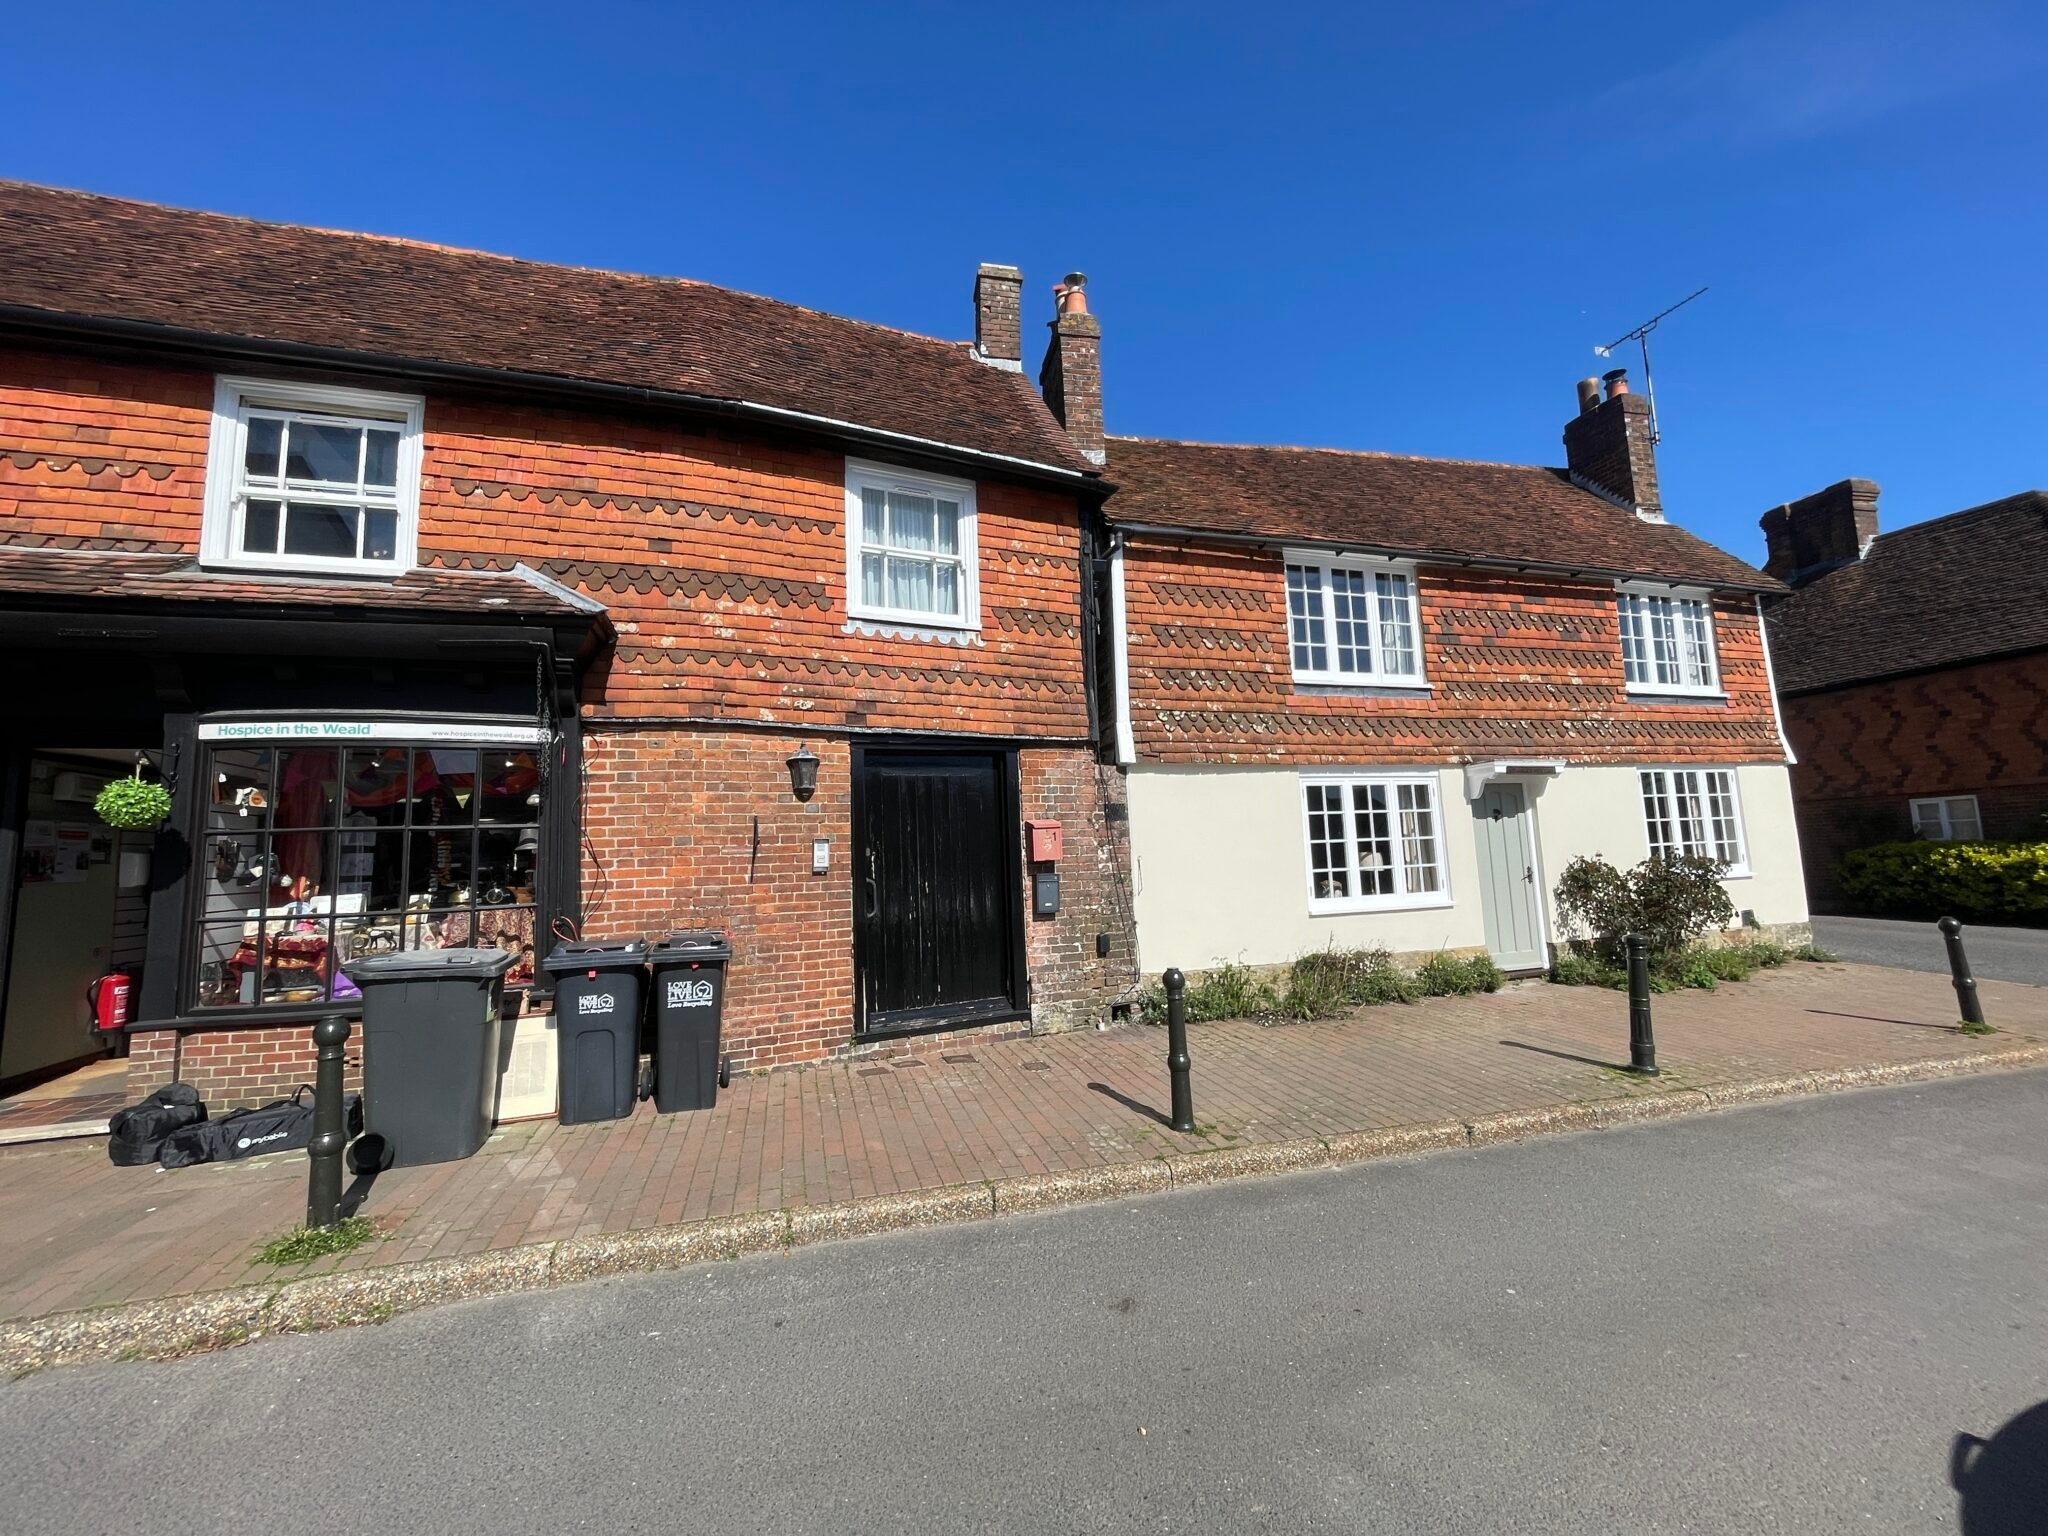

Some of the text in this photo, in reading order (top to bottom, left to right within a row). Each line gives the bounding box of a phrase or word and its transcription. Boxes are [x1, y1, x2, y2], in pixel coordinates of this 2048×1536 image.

[218, 724, 371, 737] Hospice in the Weald
[431, 731, 535, 740] www.hospiceintheweald.org.uk
[1052, 832, 1057, 841] 1
[667, 981, 693, 990] LOVE
[667, 991, 693, 1000] LIVE
[578, 1002, 598, 1010] LIVE
